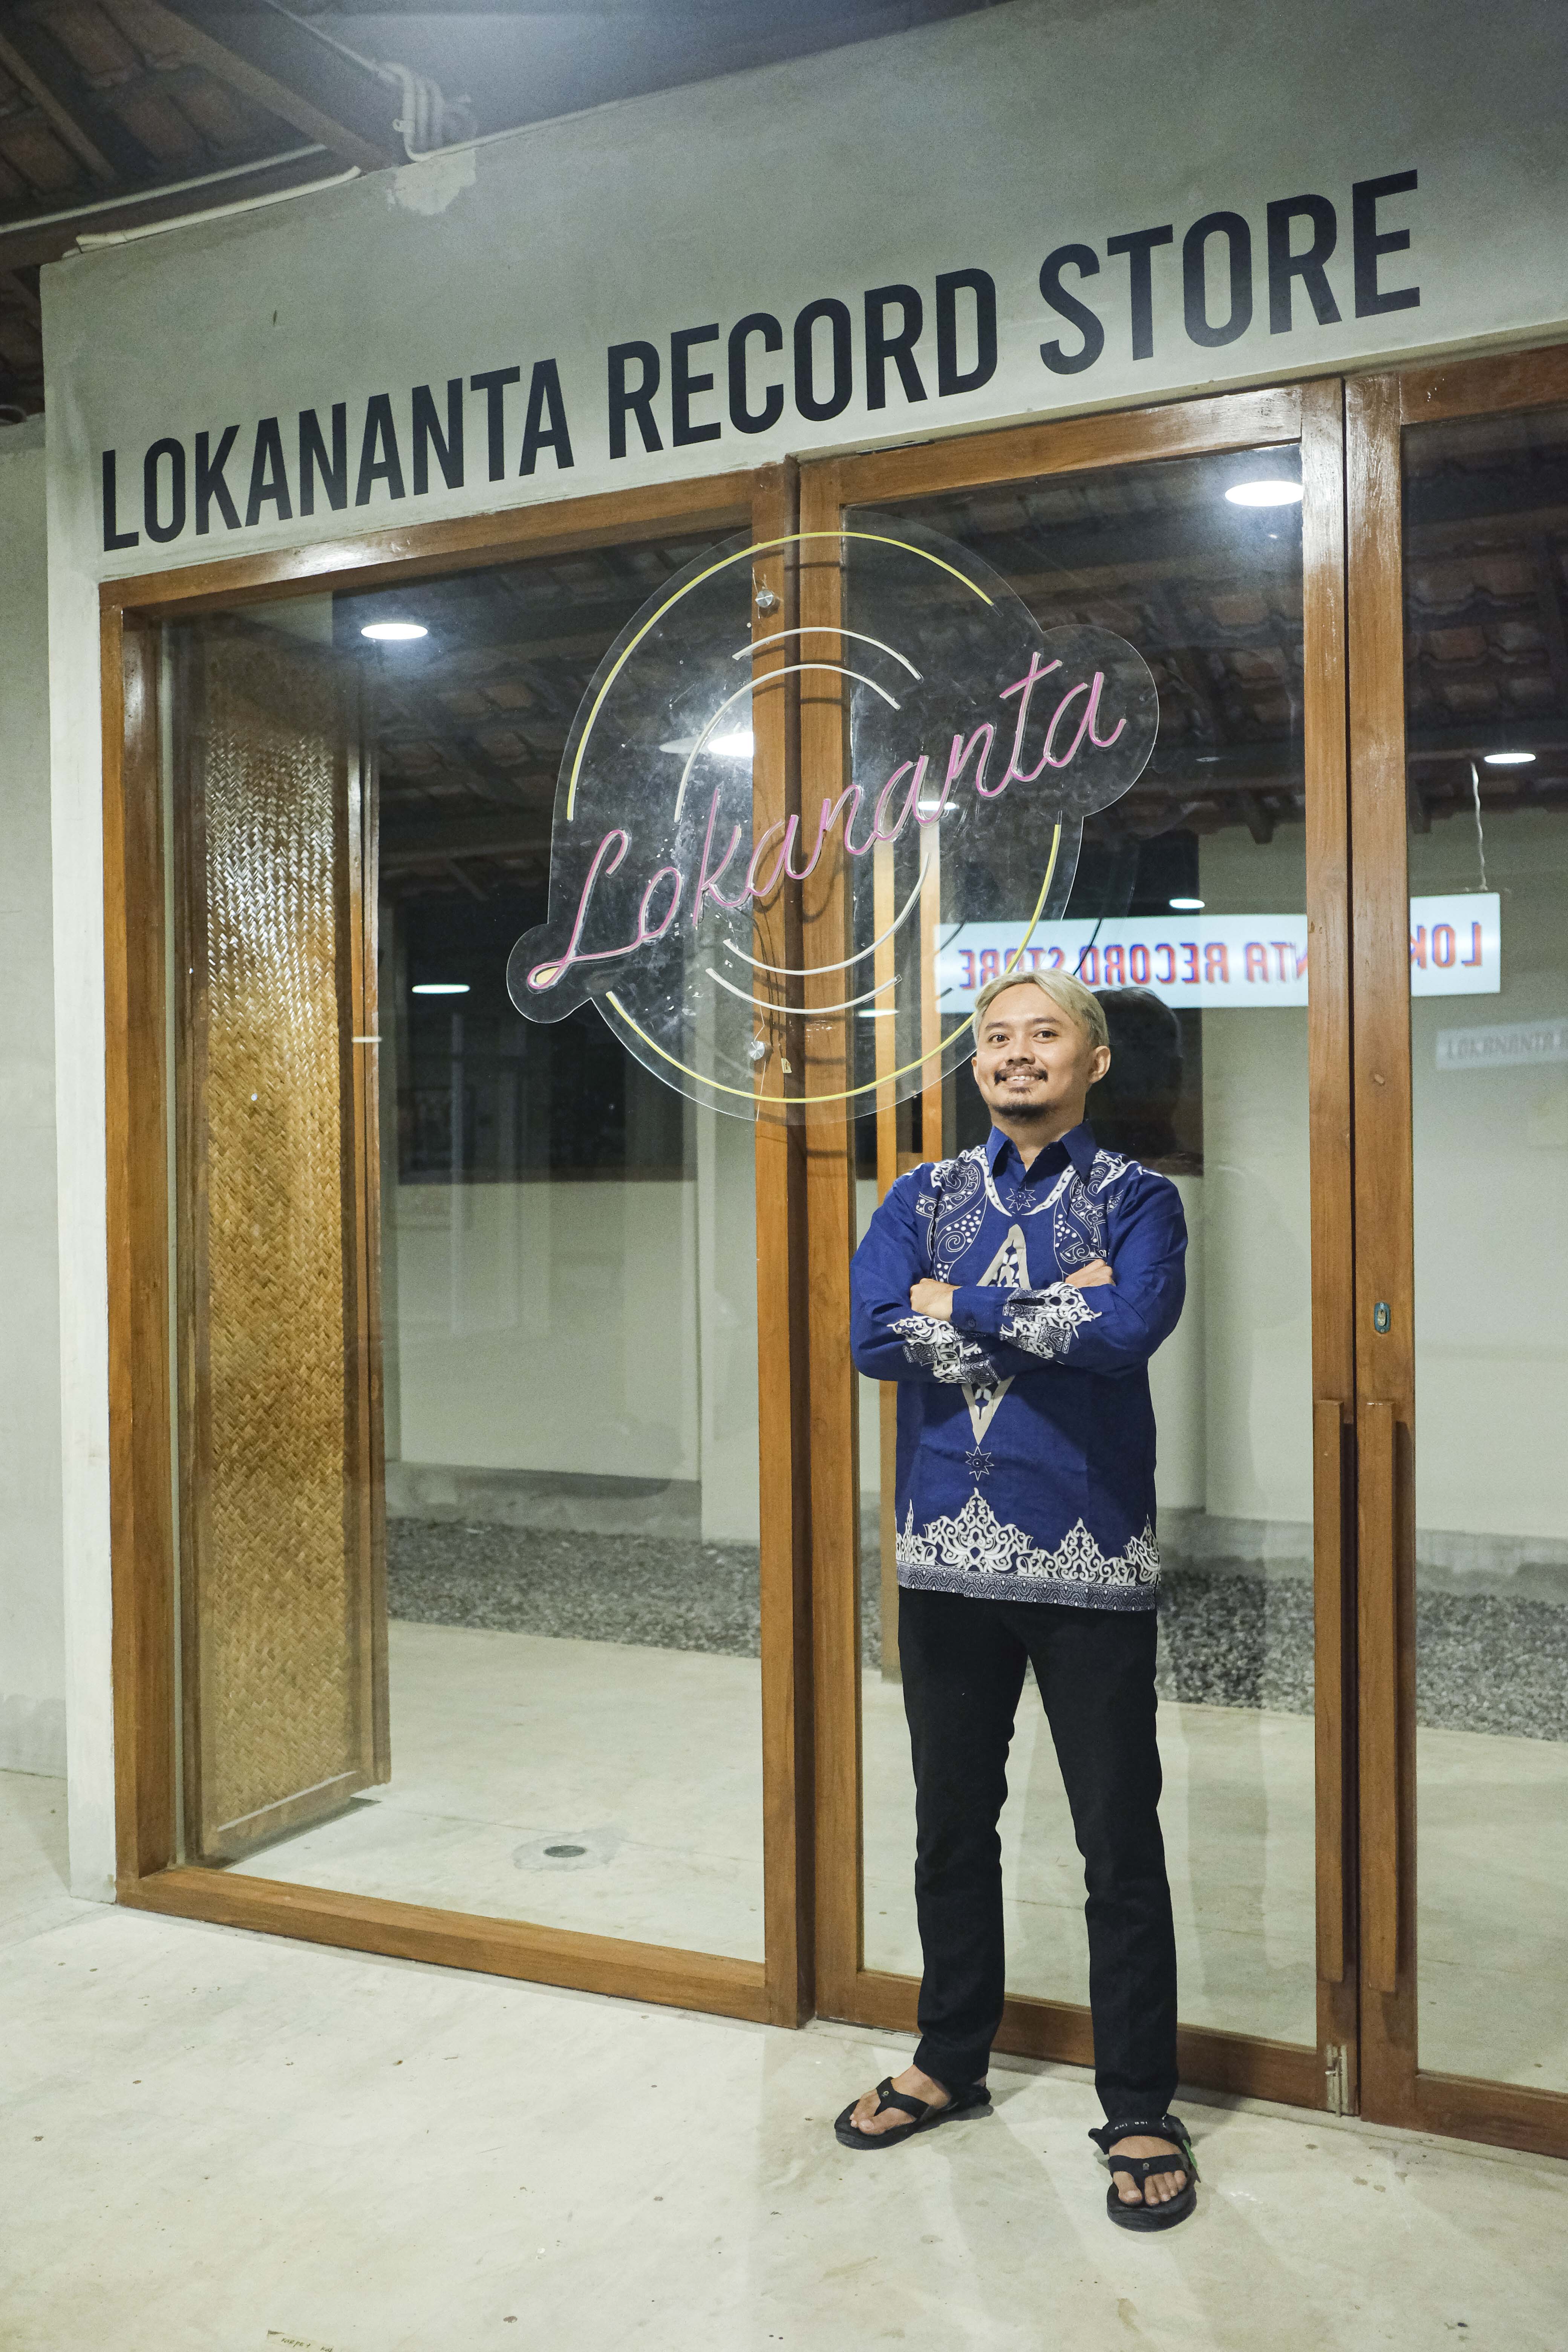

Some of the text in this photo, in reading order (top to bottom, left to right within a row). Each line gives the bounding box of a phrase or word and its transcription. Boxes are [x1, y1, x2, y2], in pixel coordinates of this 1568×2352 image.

[103, 169, 1421, 552] LOKANANTA RECORD STORE
[527, 651, 1127, 991] Lokananta
